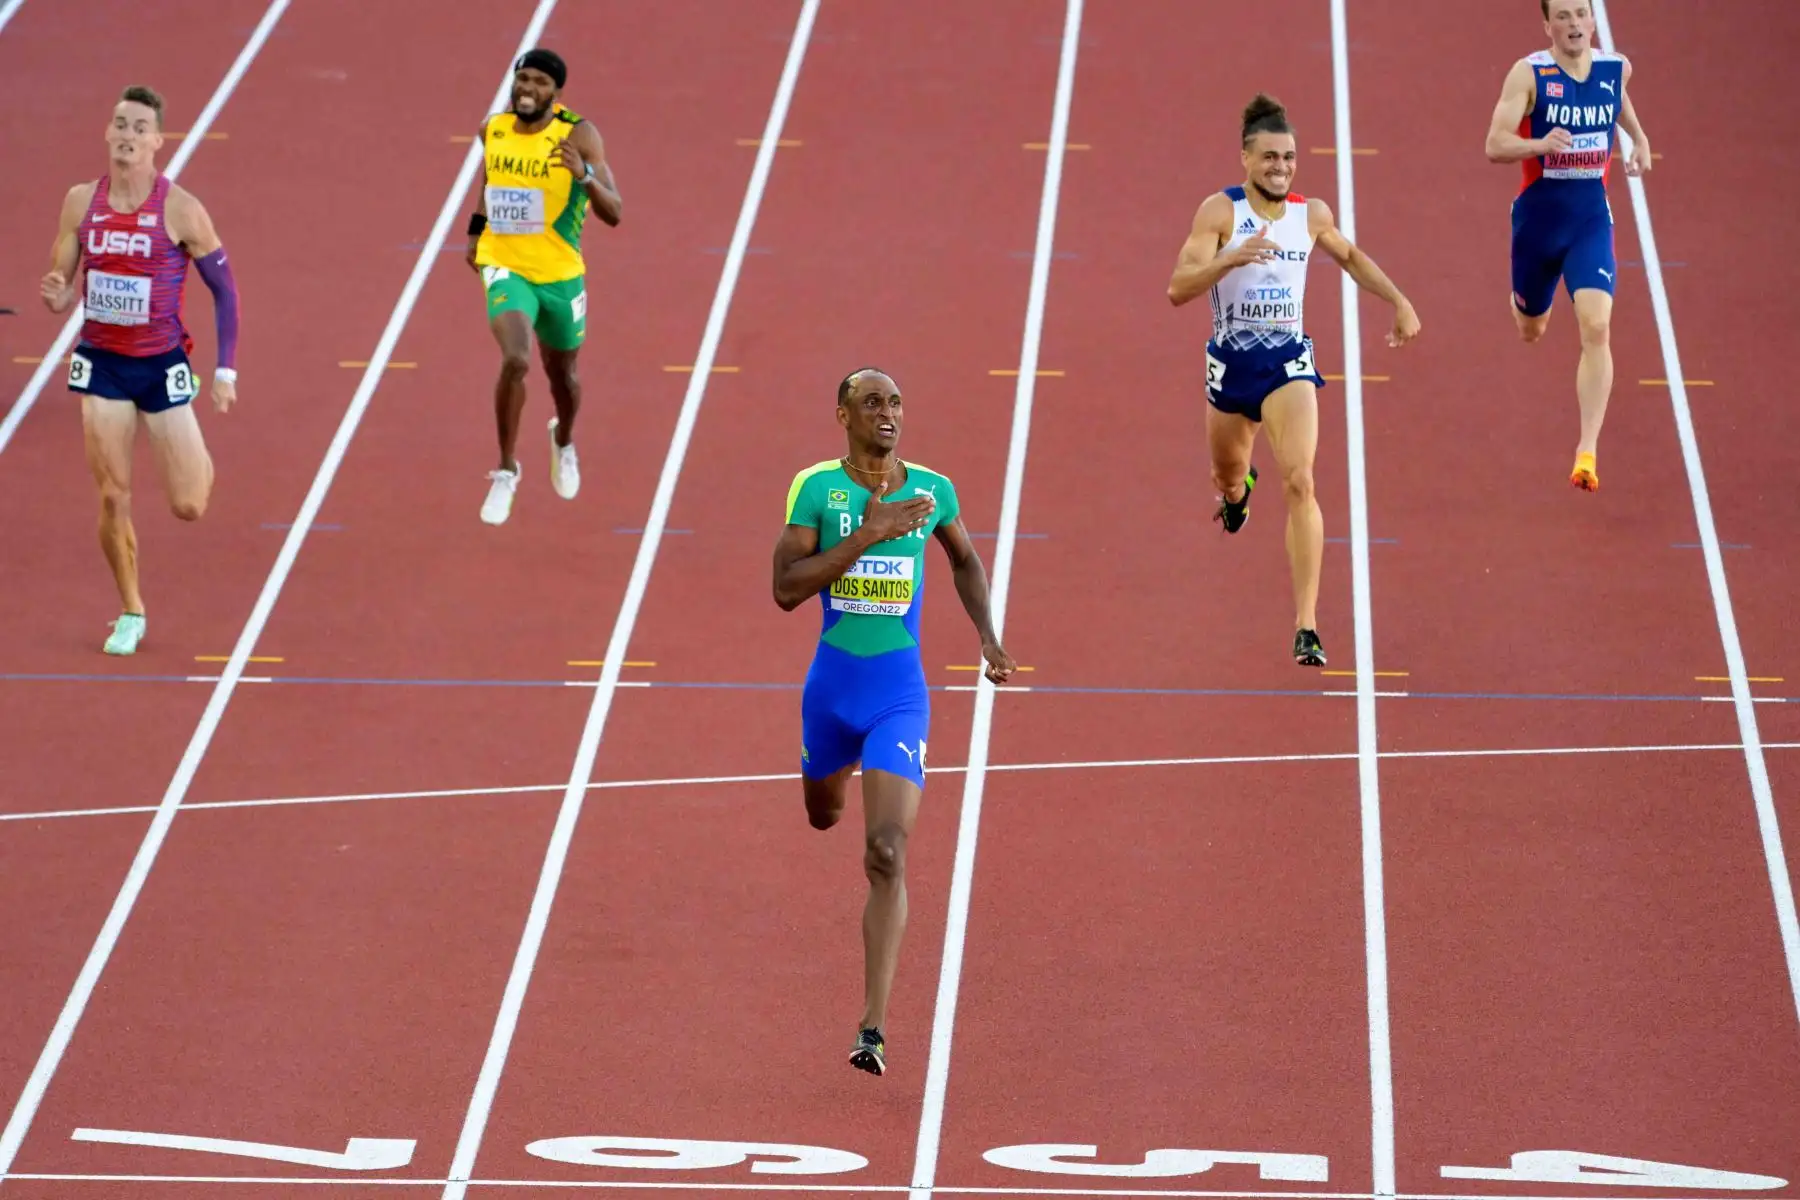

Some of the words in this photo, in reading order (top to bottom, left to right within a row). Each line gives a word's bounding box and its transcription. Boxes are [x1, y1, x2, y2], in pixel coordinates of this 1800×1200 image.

[1546, 103, 1614, 127] NORWAY
[488, 154, 550, 179] JAMAICA
[1549, 151, 1606, 168] WARHOLM
[502, 190, 533, 204] TDK
[492, 205, 529, 221] HYDE
[87, 229, 151, 258] USA
[103, 276, 139, 294] TDK
[1257, 287, 1292, 300] TDK
[90, 290, 144, 313] BASSITT
[1241, 303, 1295, 318] HAPPIO
[70, 361, 84, 380] 8
[1207, 363, 1217, 382] 5
[1295, 358, 1308, 371] 5
[174, 370, 187, 390] 8
[858, 560, 903, 575] TDK
[835, 576, 859, 596] DOS
[862, 579, 909, 599] SANTOS
[843, 602, 901, 614] OREGON22
[71, 1128, 416, 1170] 7
[524, 1135, 869, 1175] 6
[982, 1143, 1329, 1182] 5
[1440, 1150, 1789, 1190] 4
